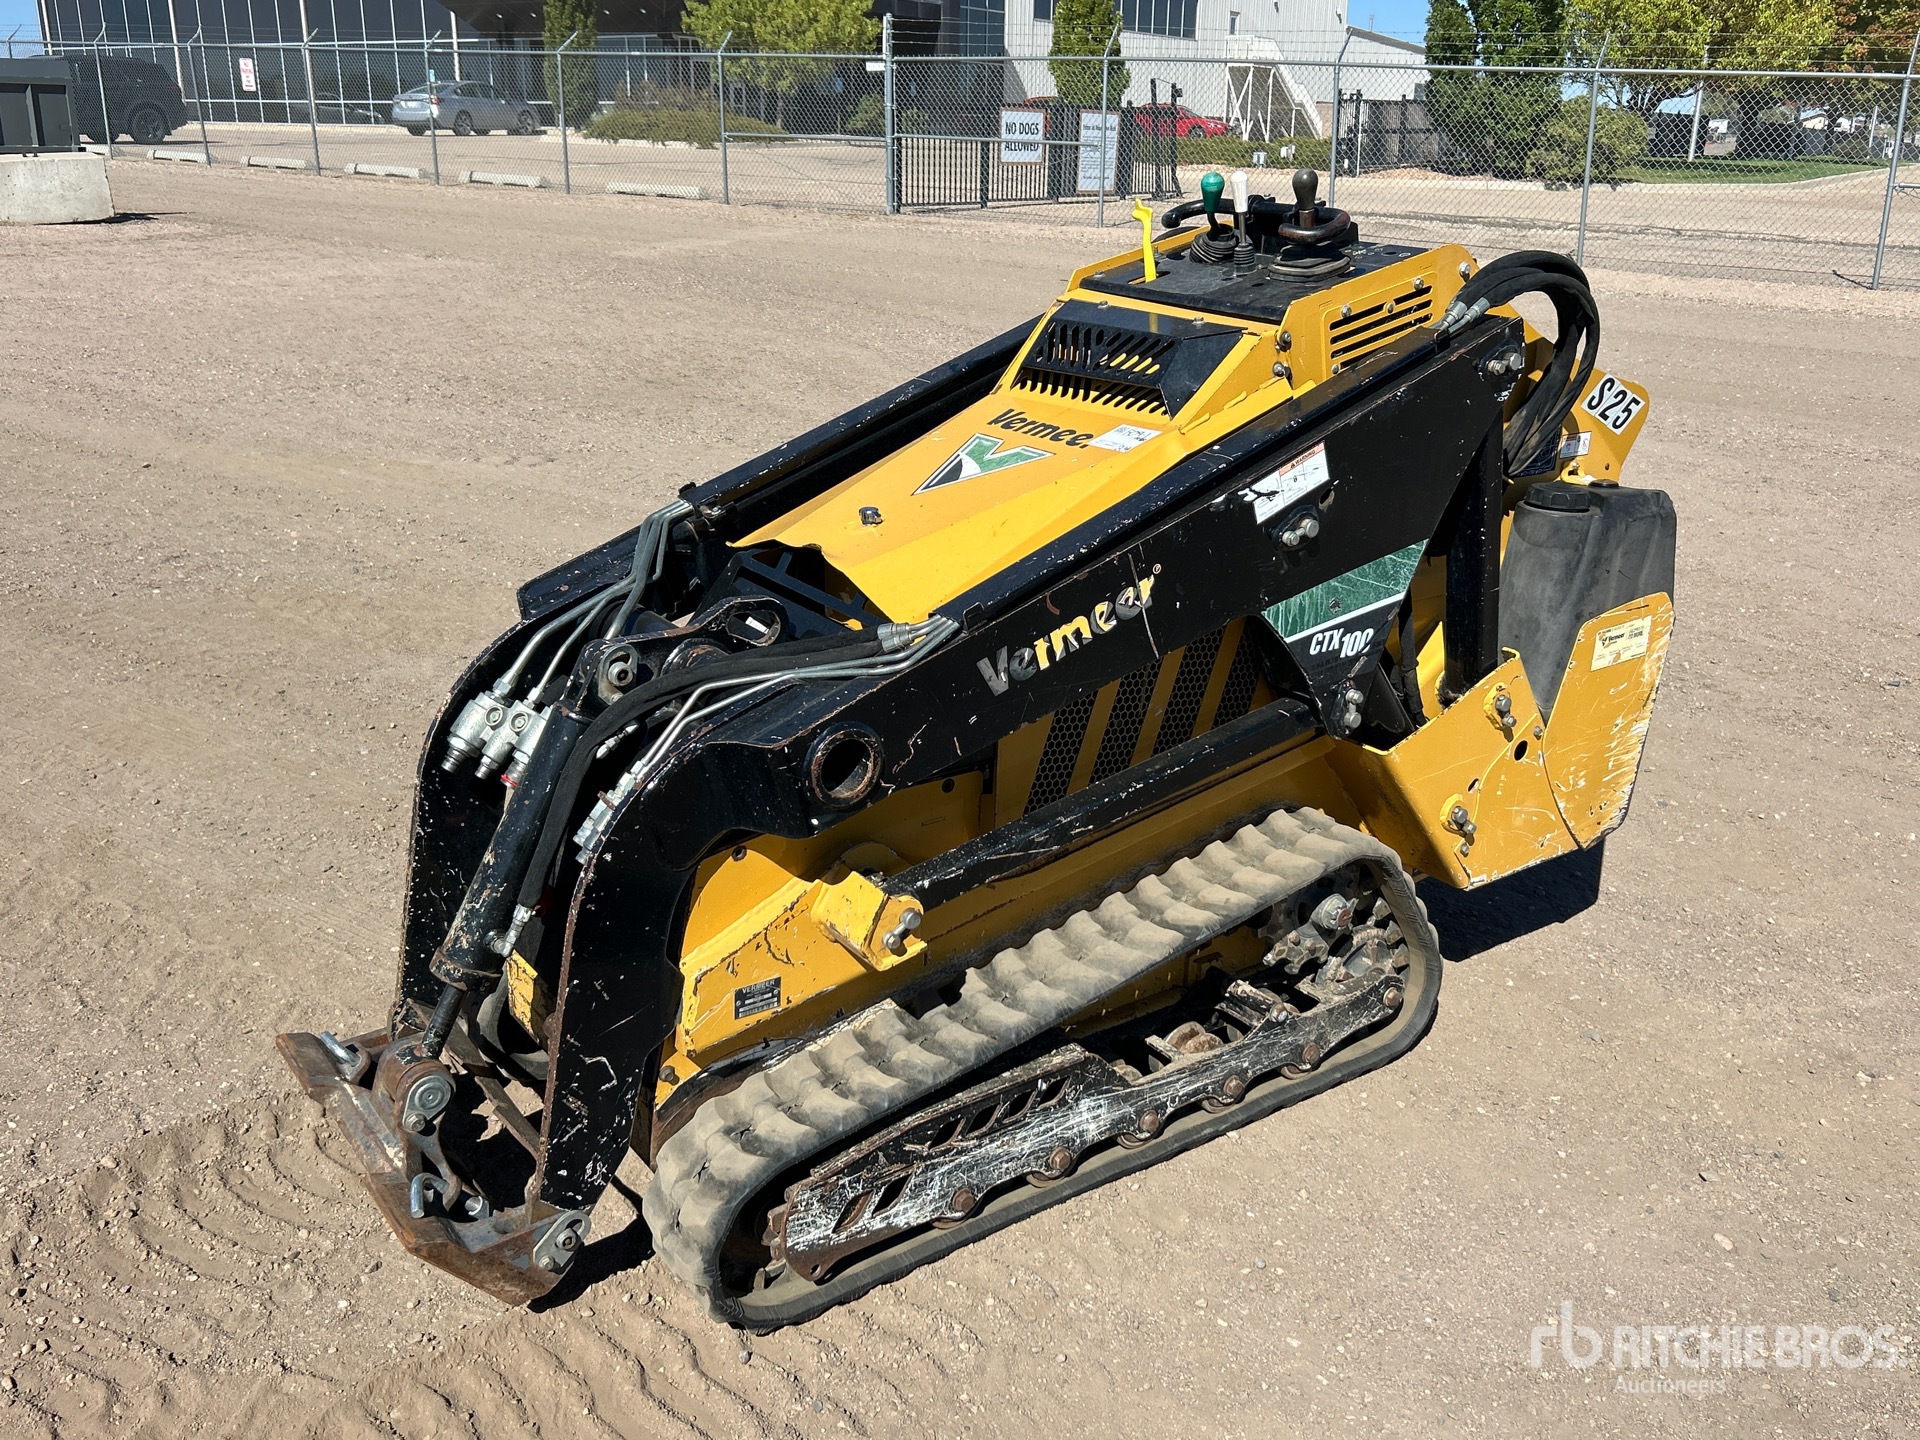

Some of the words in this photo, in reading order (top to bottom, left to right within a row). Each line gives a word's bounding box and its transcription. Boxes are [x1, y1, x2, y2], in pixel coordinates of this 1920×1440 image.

[1005, 121, 1017, 135] NO
[1019, 122, 1039, 136] DOGS
[1586, 377, 1642, 430] S25
[987, 408, 1094, 449] Vermee
[975, 573, 1156, 697] Vermeer
[1309, 627, 1375, 659] CTX100
[742, 979, 775, 994] VERMEER
